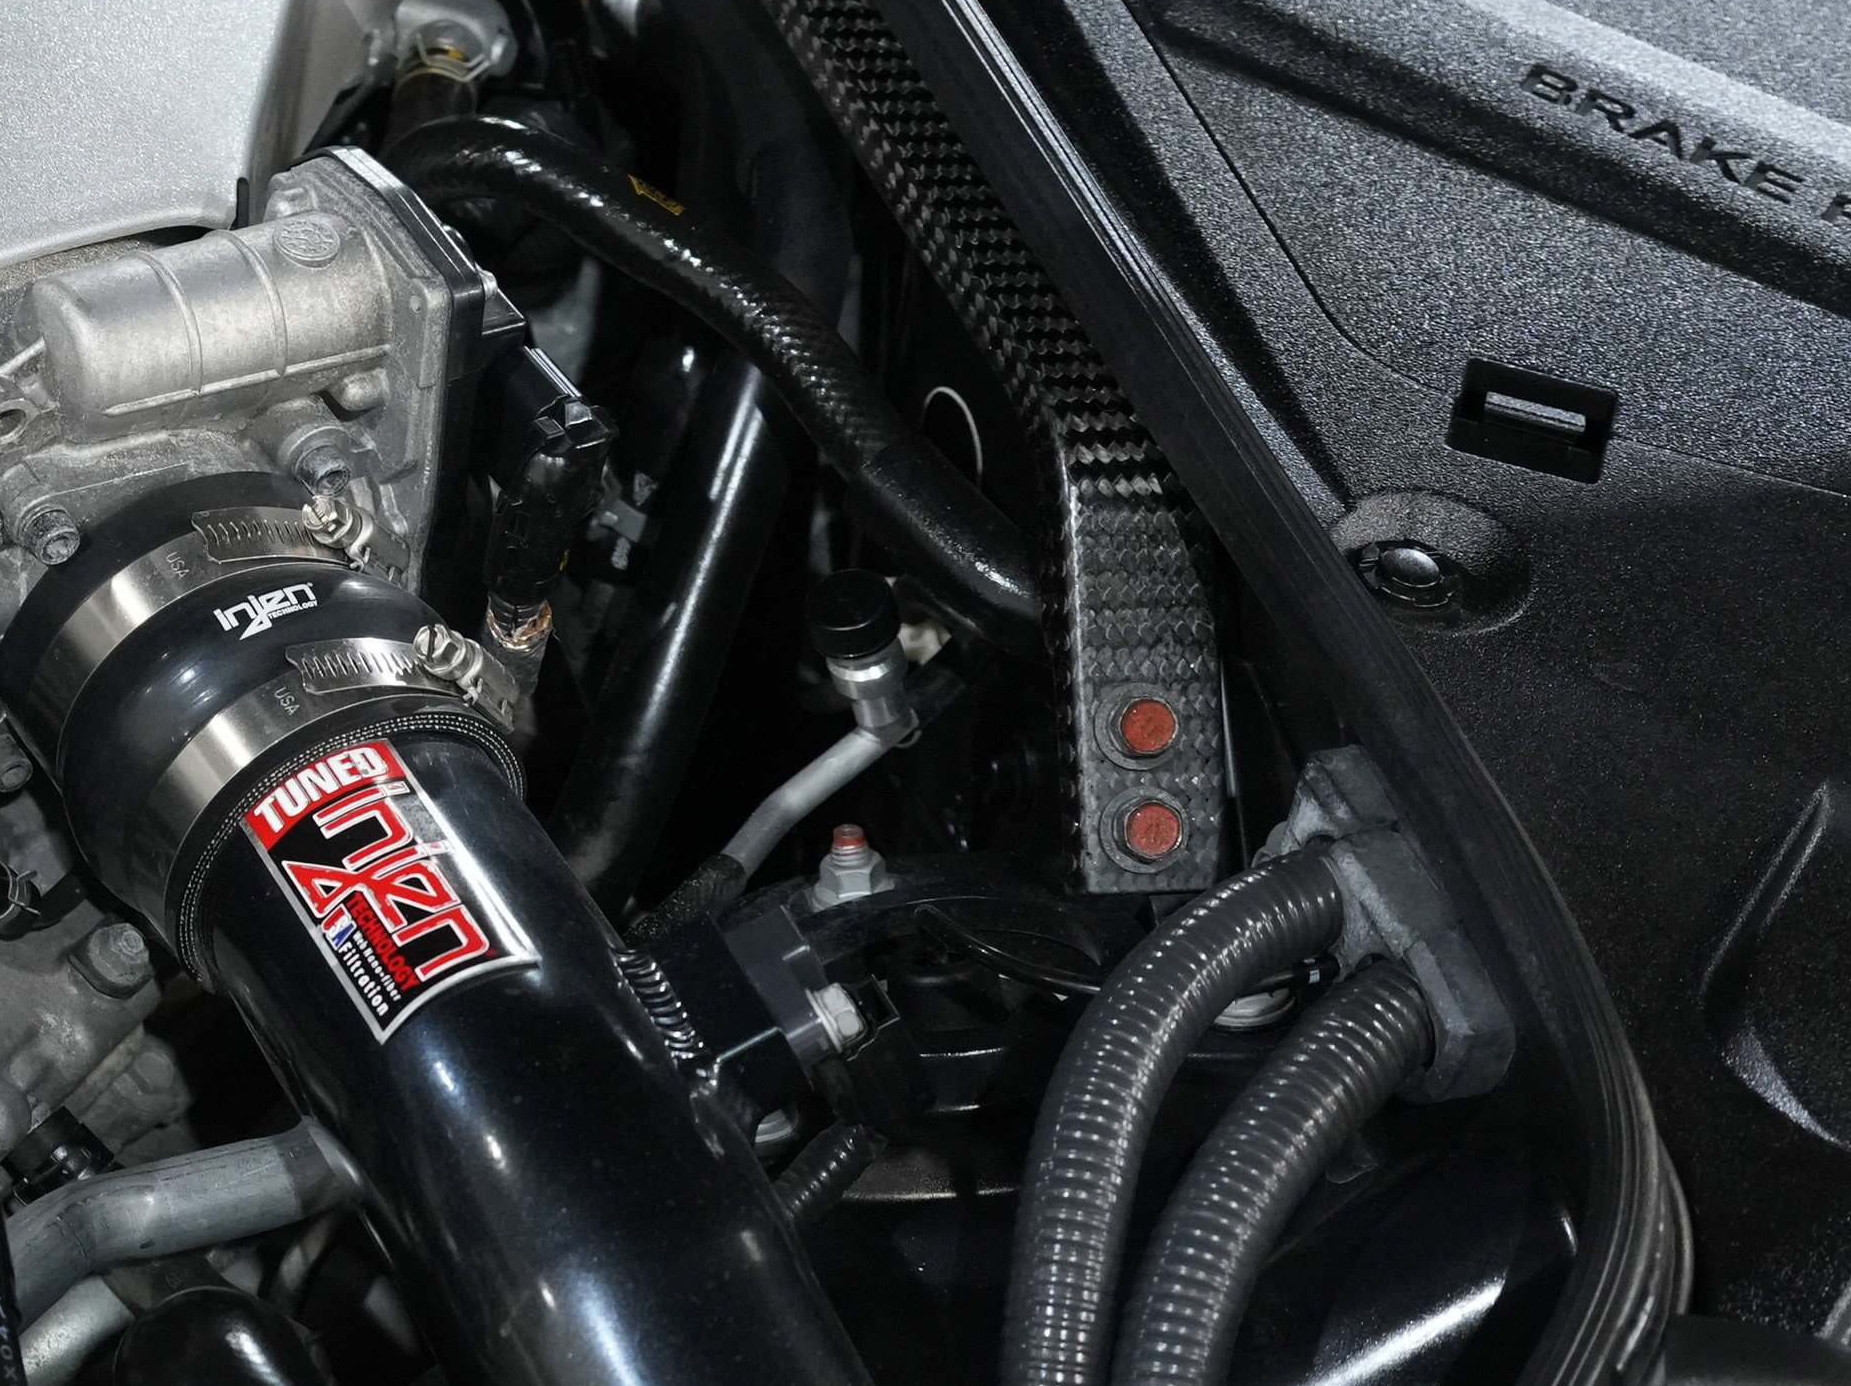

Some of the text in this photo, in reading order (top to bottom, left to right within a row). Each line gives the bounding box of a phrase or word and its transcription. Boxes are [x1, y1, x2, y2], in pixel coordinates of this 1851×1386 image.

[1520, 62, 1806, 205] BRAKE
[165, 552, 191, 579] USA
[267, 598, 318, 621] TECHNOLOGY
[271, 686, 300, 717] USA
[254, 744, 388, 835] TUNED
[282, 781, 492, 979] injen
[321, 903, 357, 951] USA
[345, 891, 420, 991] TECHNOLOGY
[338, 941, 389, 1016] Filtration
